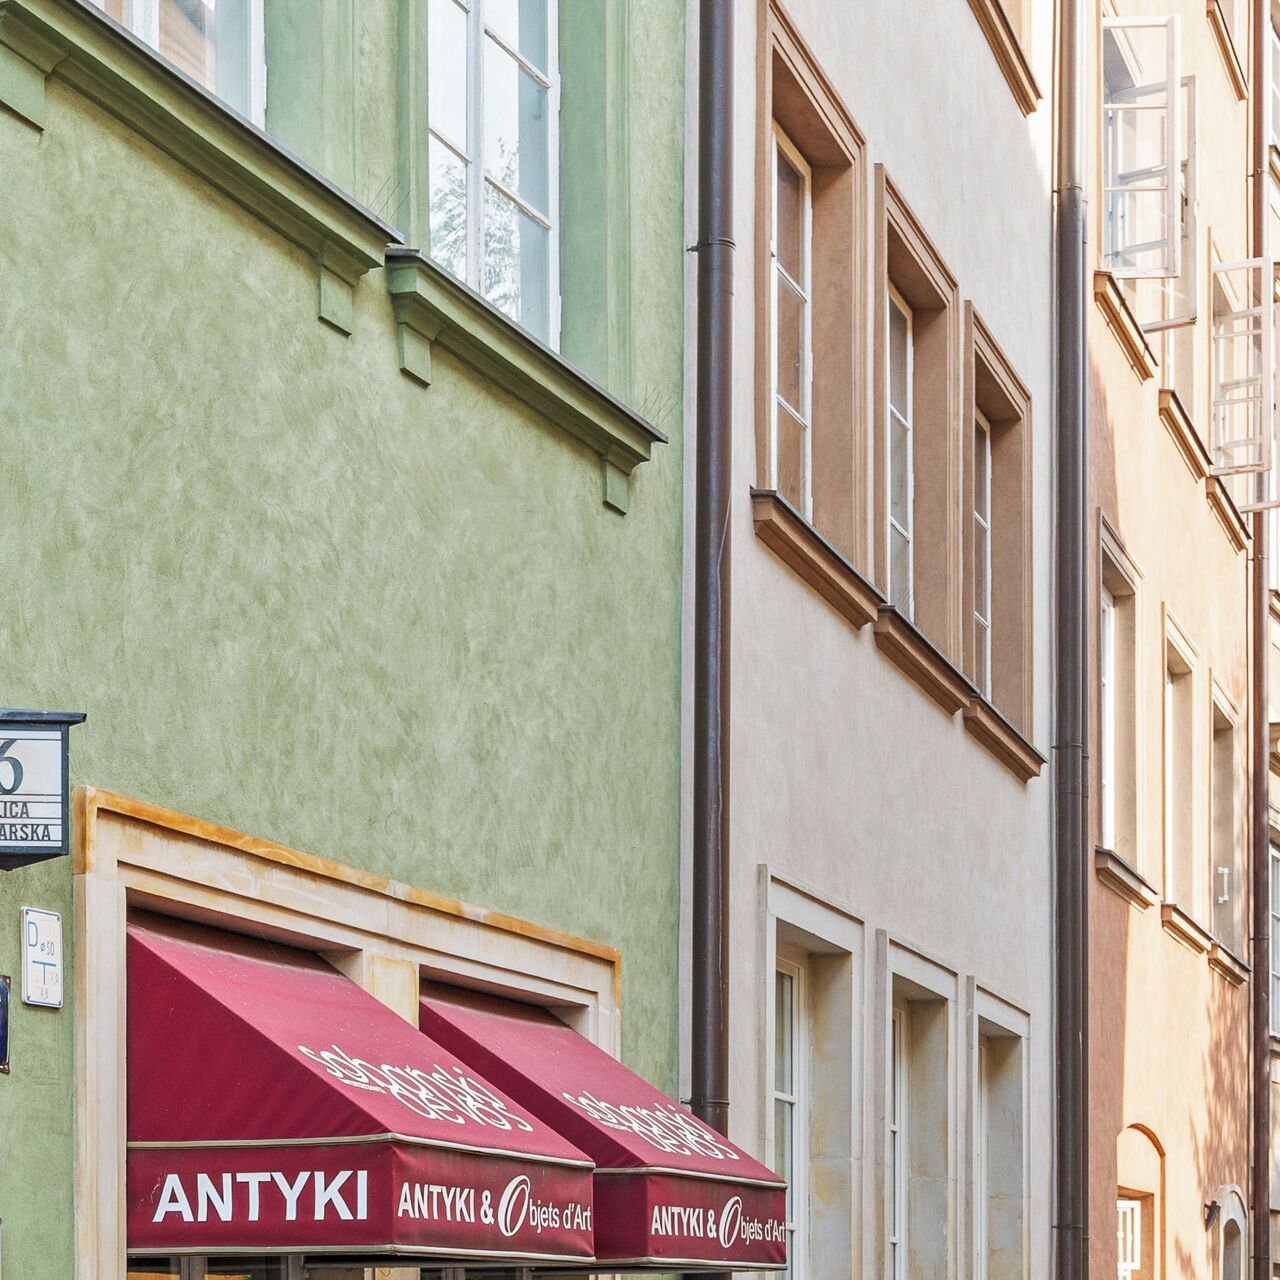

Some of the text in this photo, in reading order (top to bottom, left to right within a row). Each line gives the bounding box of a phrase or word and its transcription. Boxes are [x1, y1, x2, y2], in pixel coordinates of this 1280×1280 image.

[27, 921, 38, 947] D
[152, 1170, 367, 1222] ANTYKI
[397, 1182, 475, 1223] ANTYKI
[480, 1190, 494, 1225] &
[651, 1205, 704, 1237] ANTYKI
[707, 1209, 717, 1239] &
